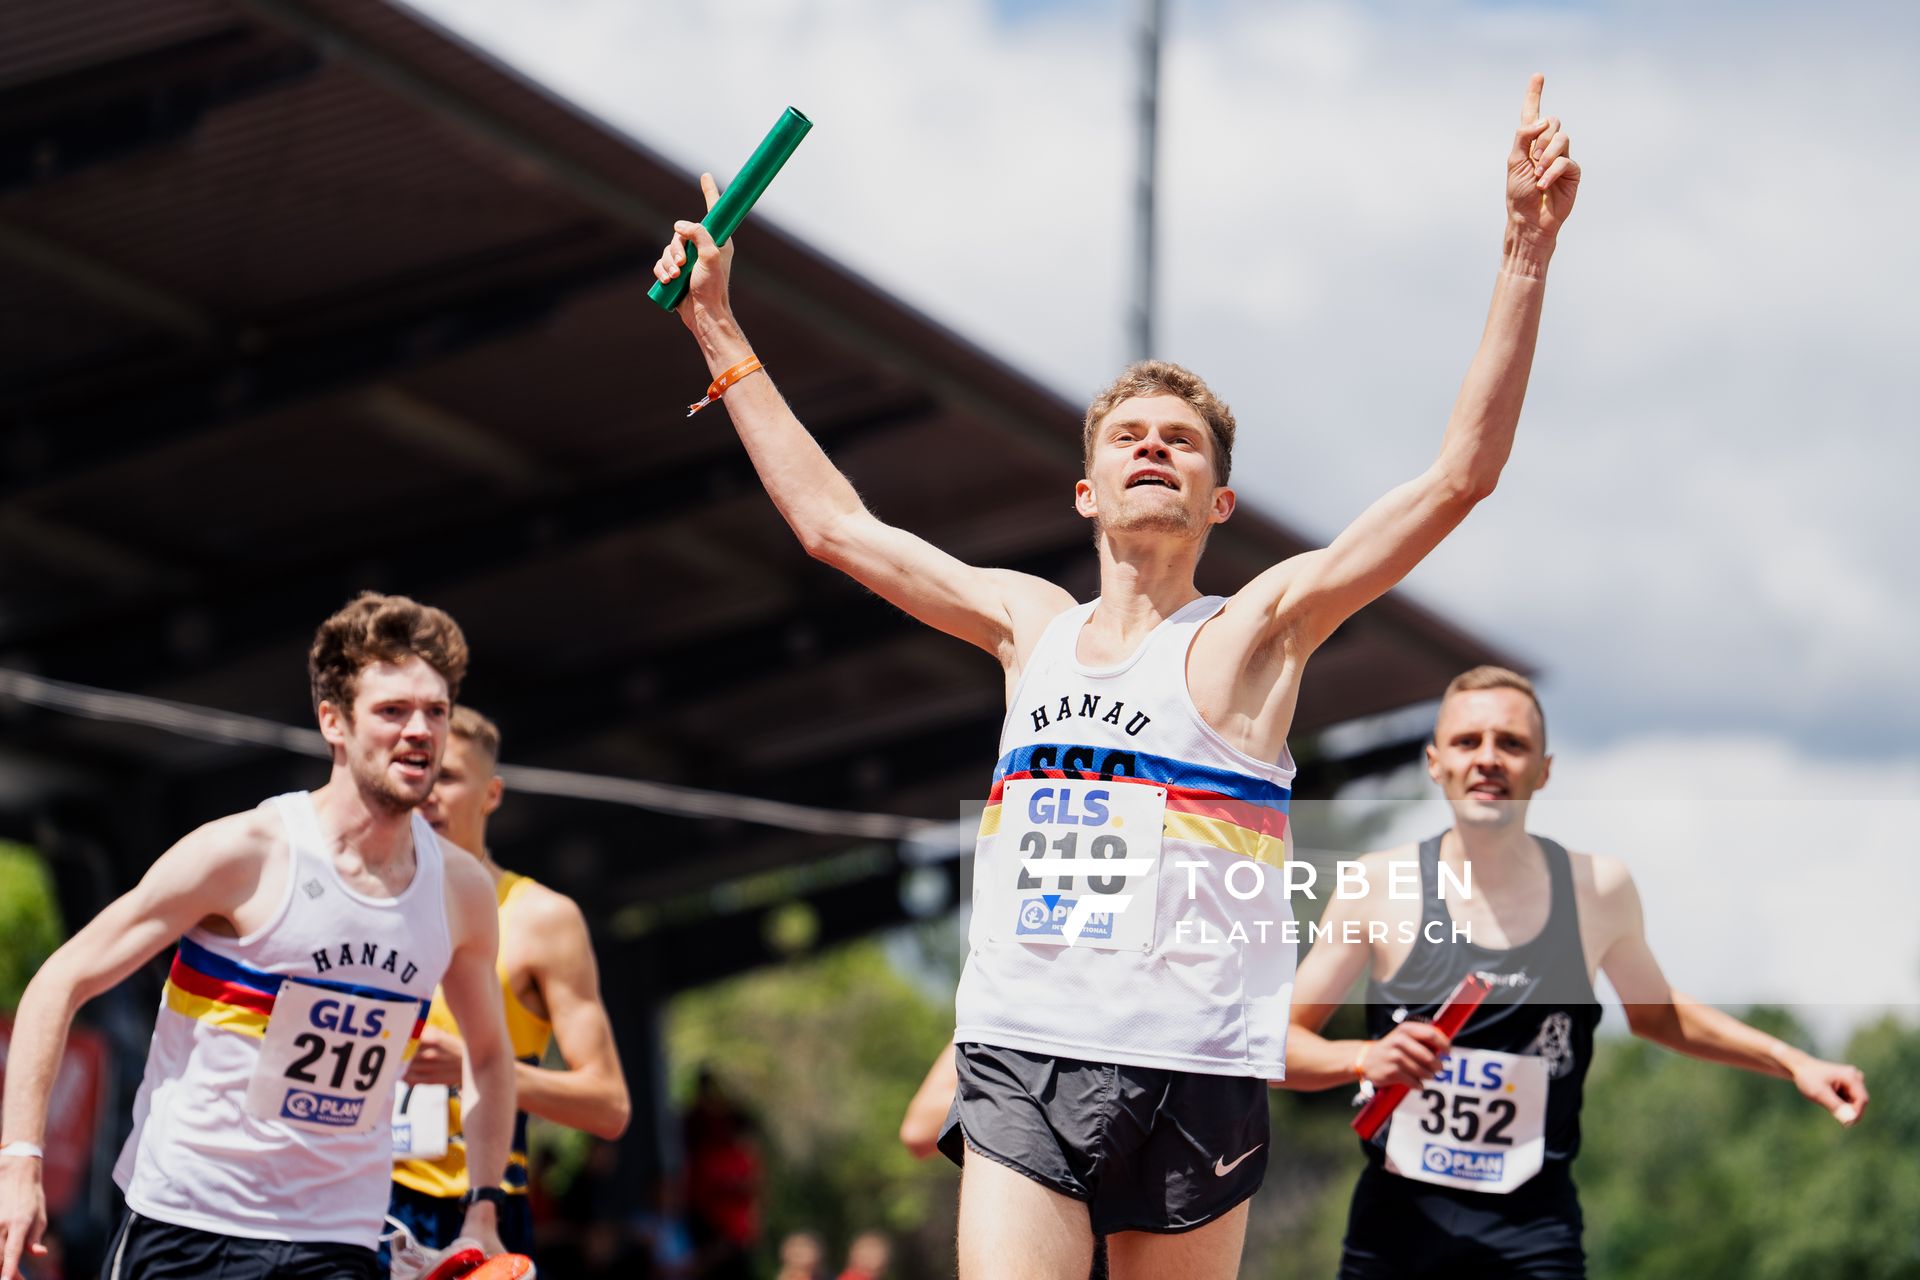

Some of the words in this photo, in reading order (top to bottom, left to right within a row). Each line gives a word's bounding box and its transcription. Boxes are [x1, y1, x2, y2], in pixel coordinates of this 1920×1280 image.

[1030, 693, 1152, 737] HANAU
[1052, 905, 1110, 926] PAN
[312, 942, 418, 984] HANAU
[284, 1033, 386, 1092] 219
[320, 1099, 361, 1117] PLAN
[1420, 1088, 1517, 1146] 352
[1453, 1154, 1503, 1173] PLAN
